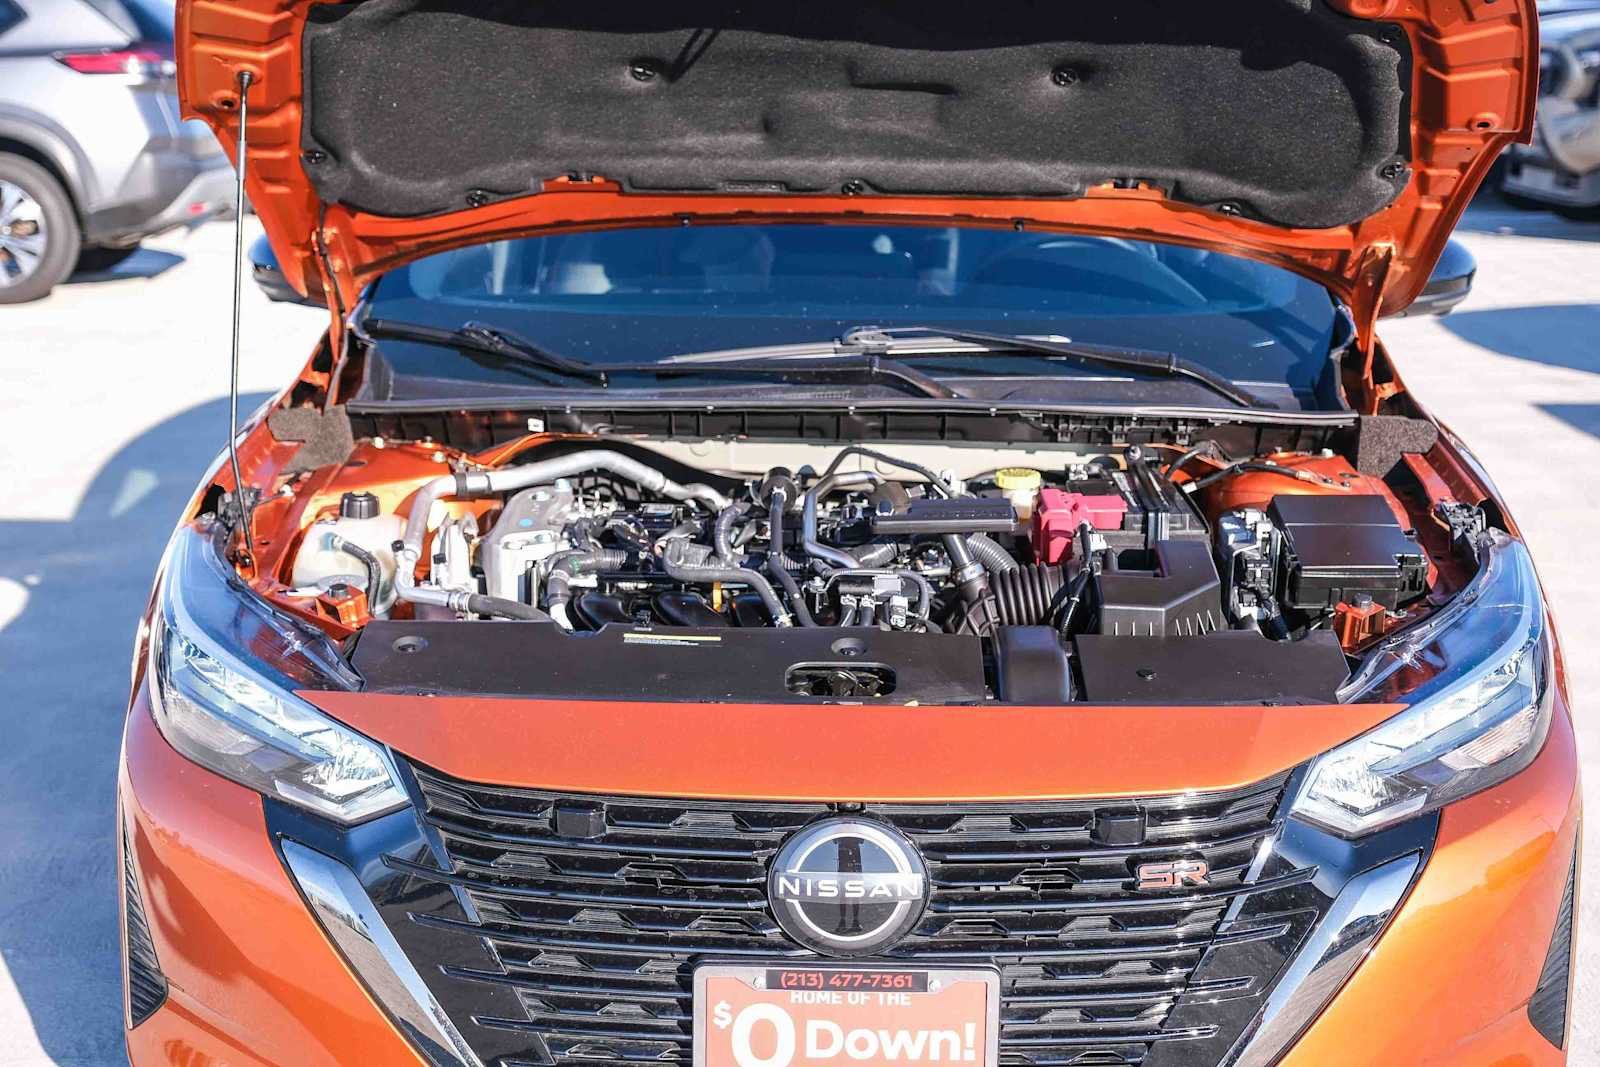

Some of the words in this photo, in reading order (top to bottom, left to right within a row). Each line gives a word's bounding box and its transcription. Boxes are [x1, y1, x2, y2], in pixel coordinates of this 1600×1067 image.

[1137, 861, 1208, 889] SR
[778, 876, 919, 898] NISSAN
[780, 971, 825, 989] (213)
[829, 973, 914, 988] 477-7361
[789, 991, 843, 1005] HOME
[847, 992, 871, 1006] OF
[878, 993, 912, 1007] THE
[805, 1019, 977, 1061] Down!
